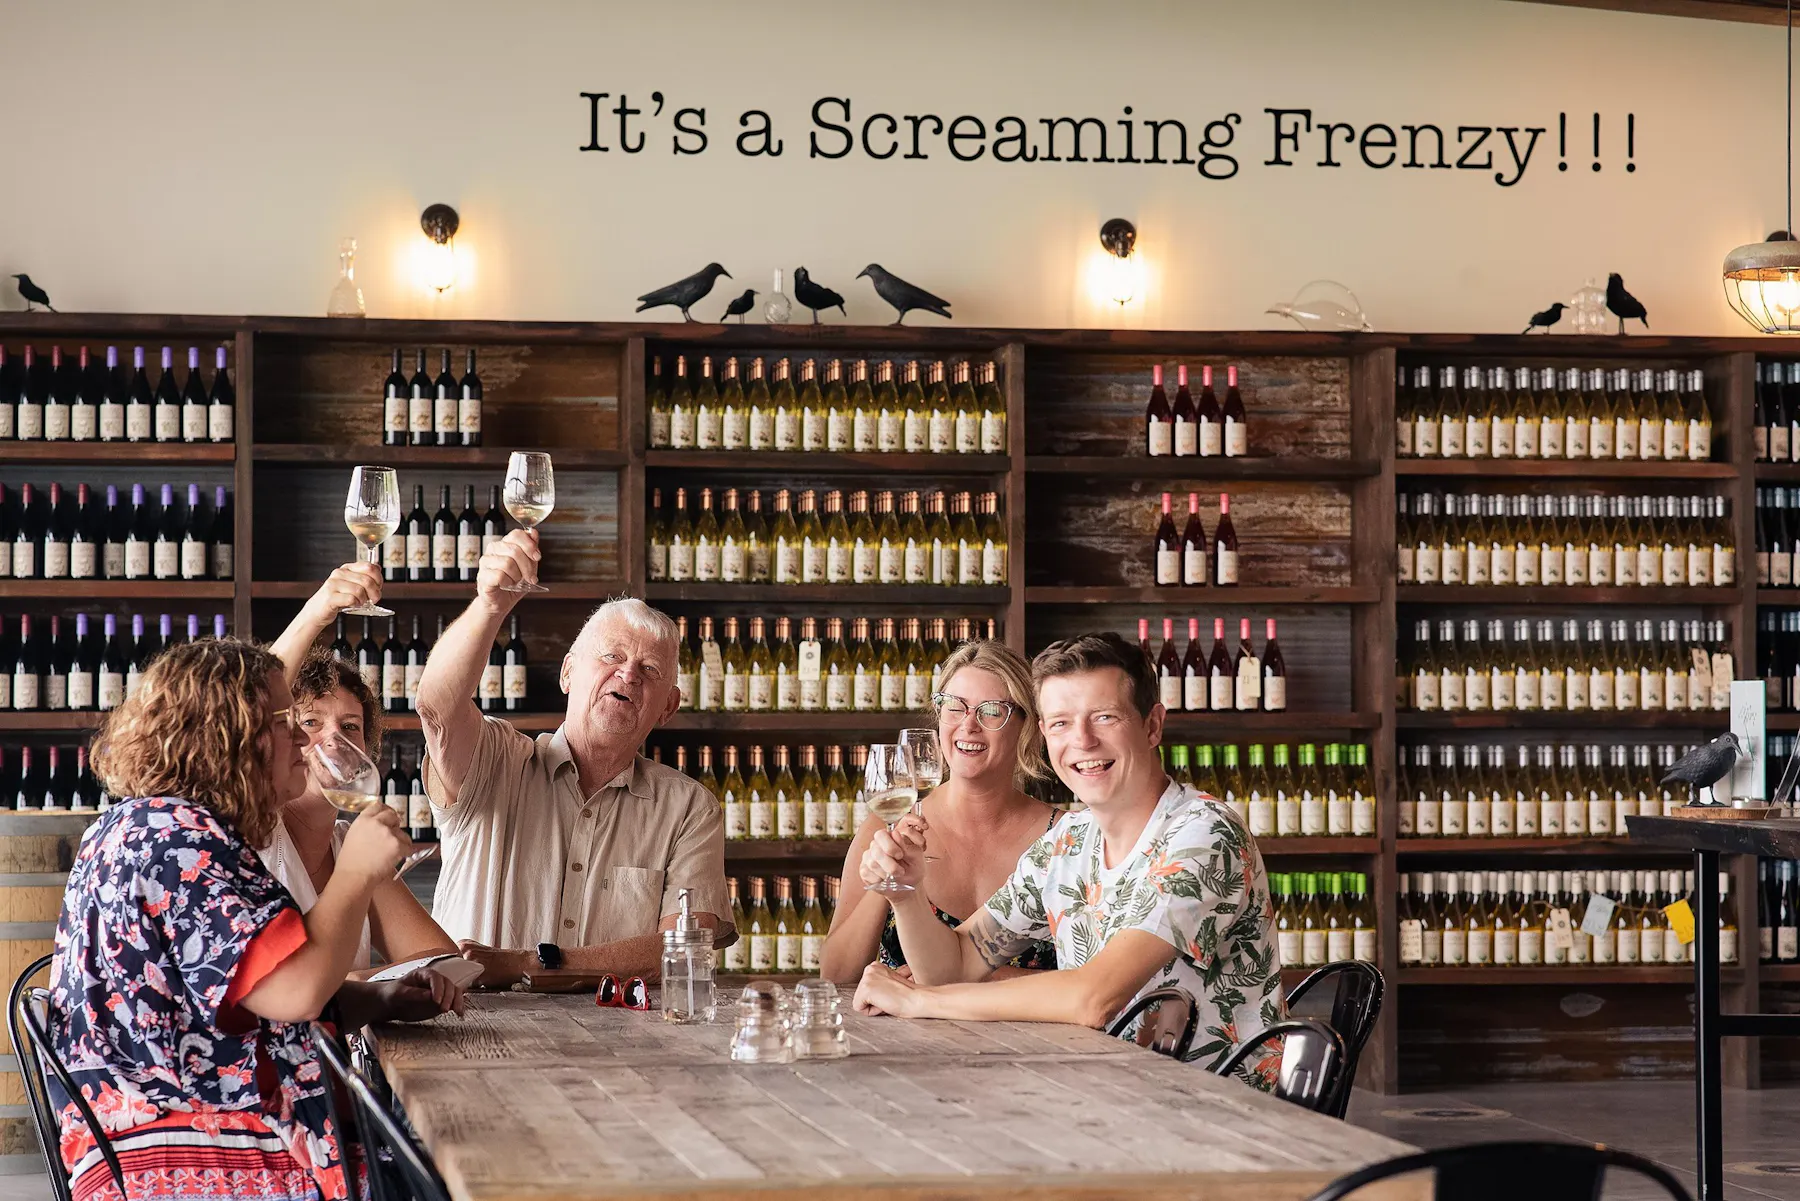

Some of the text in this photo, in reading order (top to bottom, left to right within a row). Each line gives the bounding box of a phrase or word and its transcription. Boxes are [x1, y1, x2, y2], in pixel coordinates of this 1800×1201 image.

[578, 91, 1638, 187] It's a Screaming Frenzy!!!
